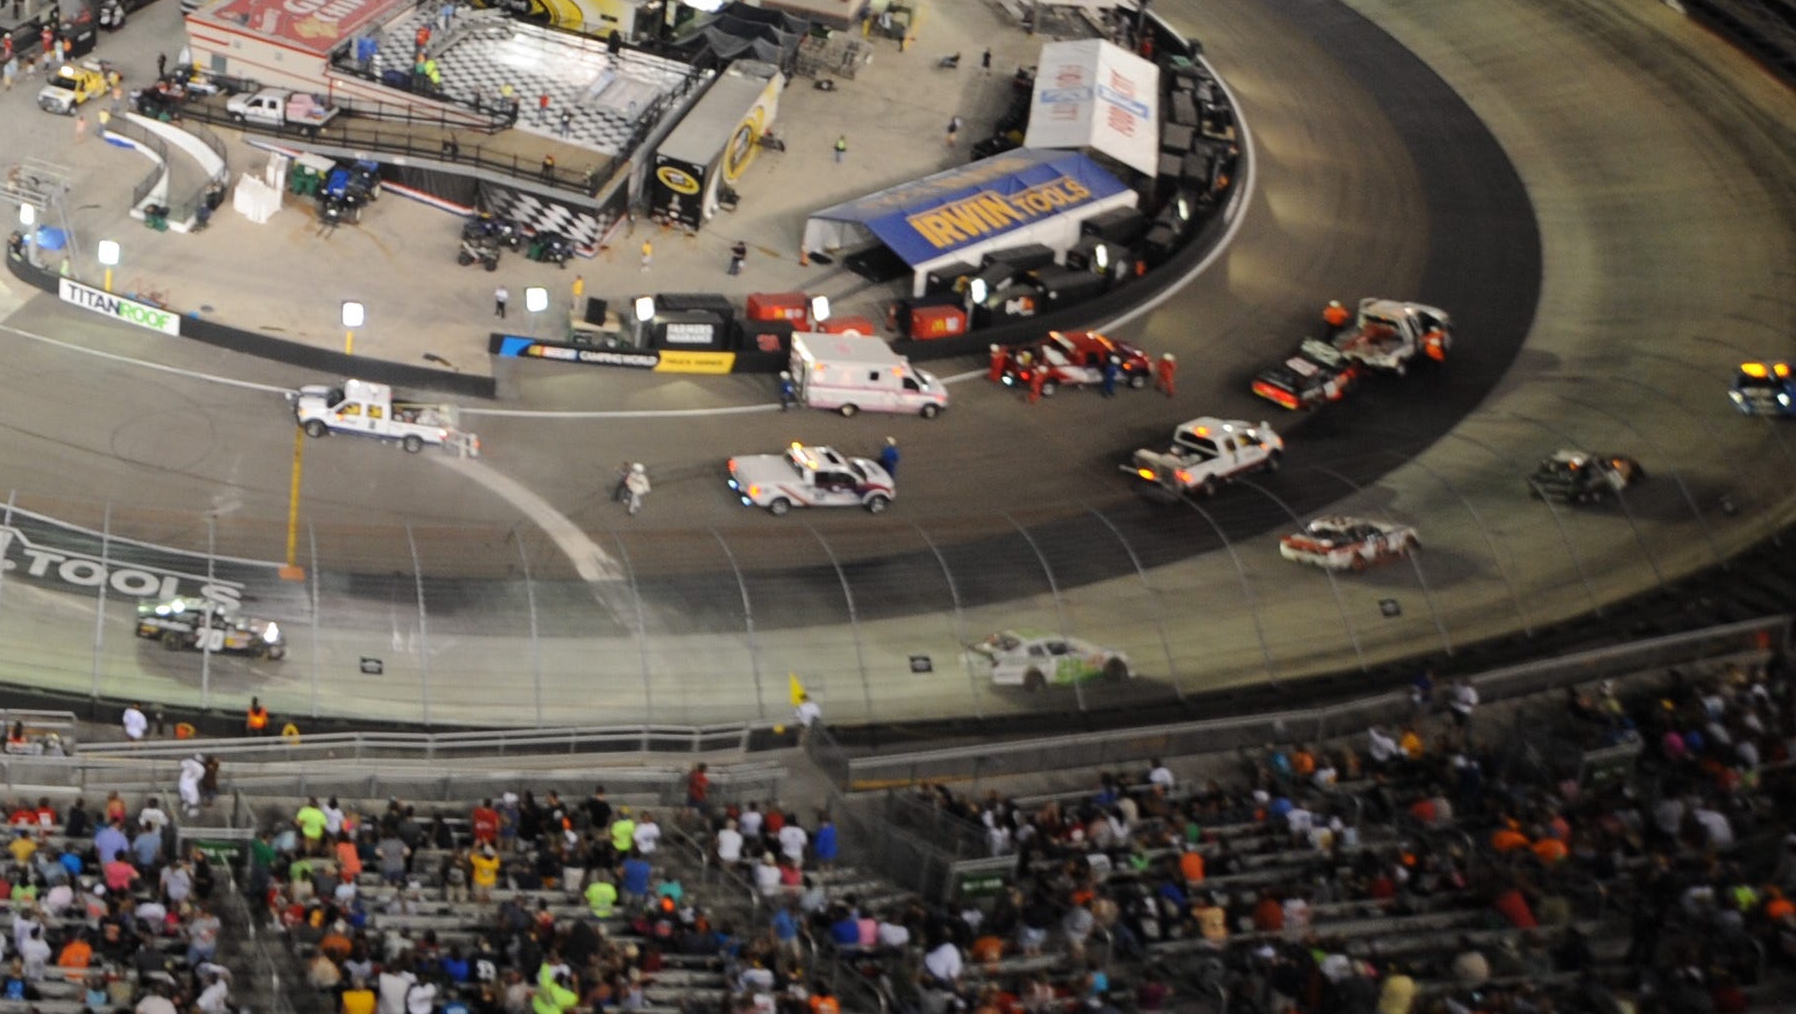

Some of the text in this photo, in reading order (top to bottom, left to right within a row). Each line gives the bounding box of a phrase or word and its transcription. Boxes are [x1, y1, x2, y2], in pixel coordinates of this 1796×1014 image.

[910, 191, 1024, 248] IRWIN
[1014, 177, 1092, 217] TOOLS
[23, 547, 242, 611] TOOLS
